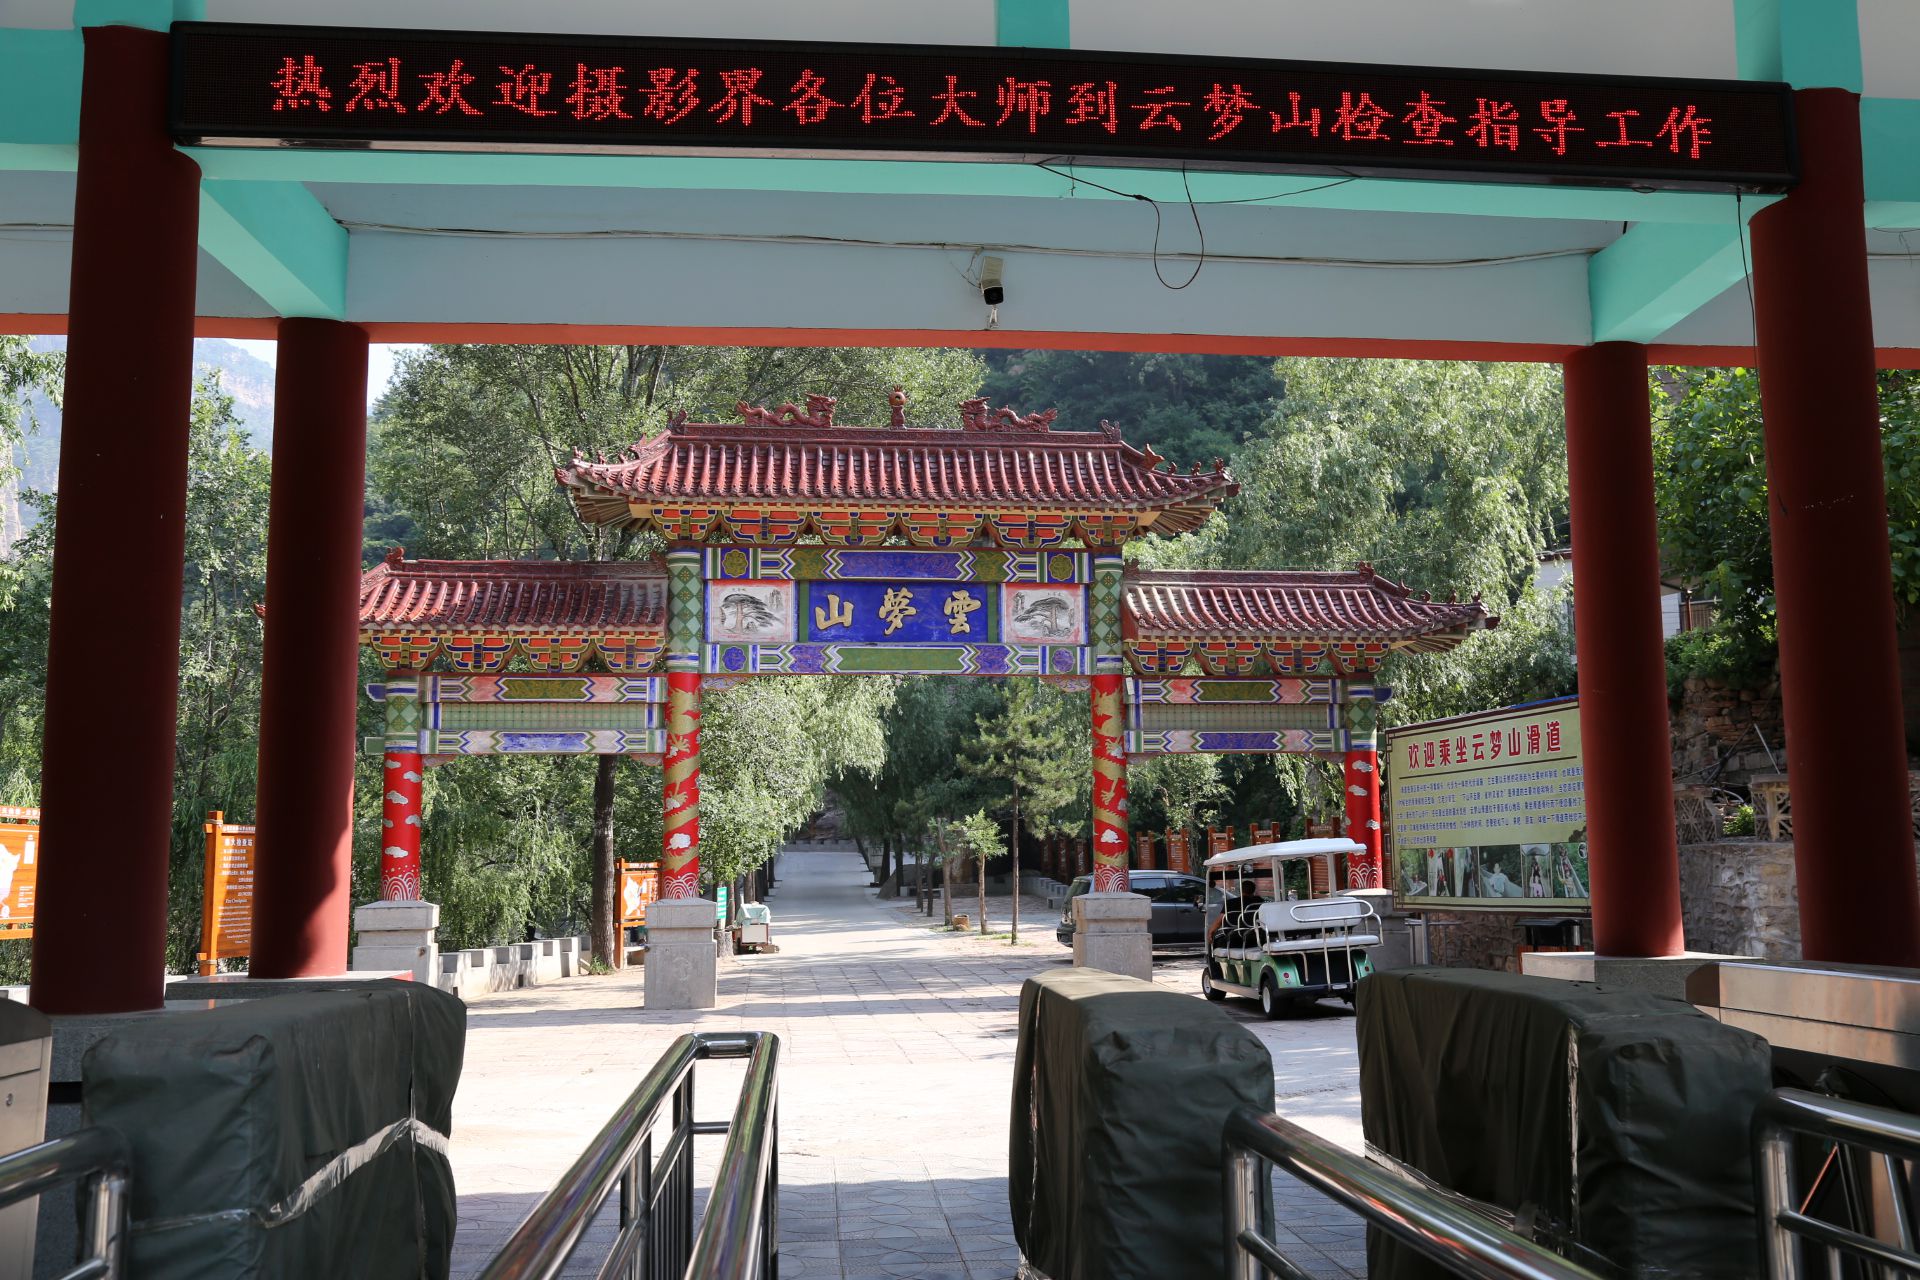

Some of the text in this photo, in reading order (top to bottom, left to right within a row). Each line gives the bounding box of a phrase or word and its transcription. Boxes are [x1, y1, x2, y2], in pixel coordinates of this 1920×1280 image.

[272, 55, 1713, 159] 热烈欢迎摄影界各位大师到云梦山检查指导工作
[1408, 721, 1561, 769] 欢迎乘坐云梦山滑道
